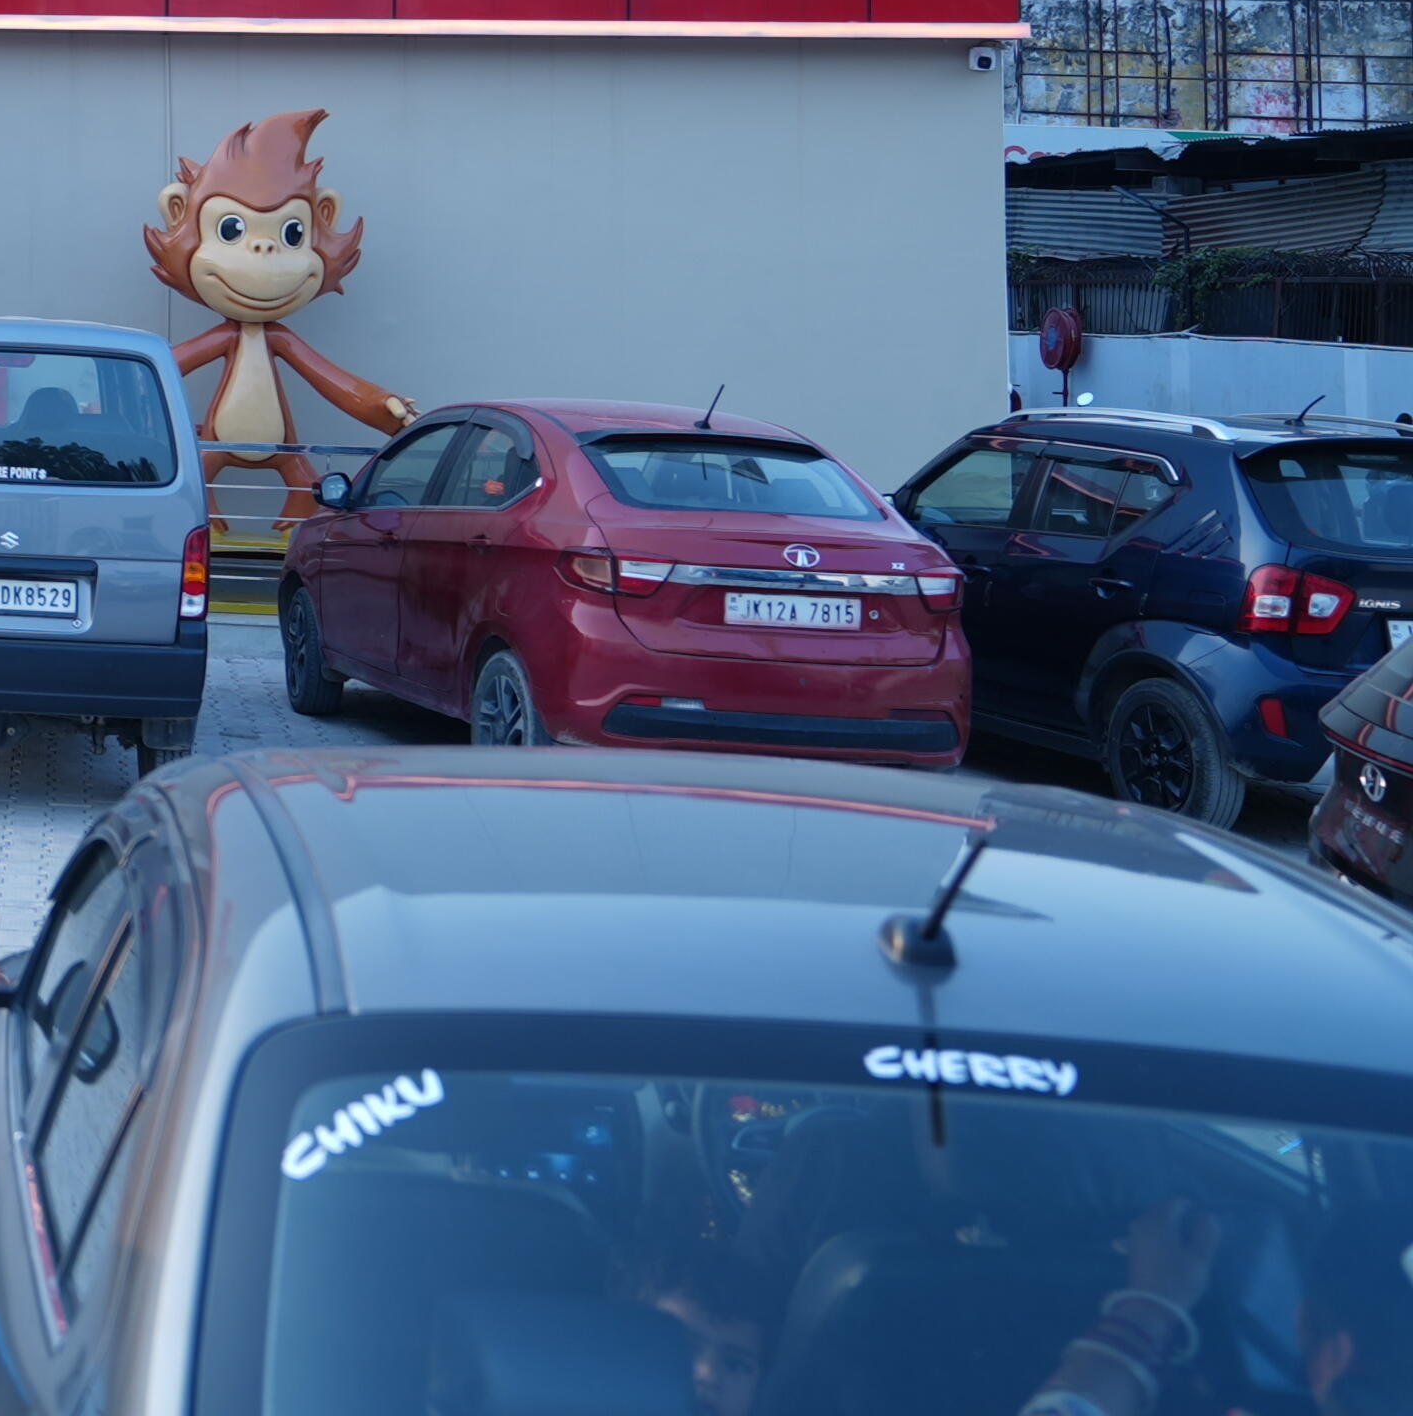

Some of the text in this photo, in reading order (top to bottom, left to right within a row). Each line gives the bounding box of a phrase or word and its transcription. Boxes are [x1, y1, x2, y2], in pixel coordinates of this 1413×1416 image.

[740, 598, 798, 622] JK12A
[810, 601, 855, 625] 7815
[1358, 597, 1402, 610] IGNIS
[863, 1044, 1078, 1097] CHERRY
